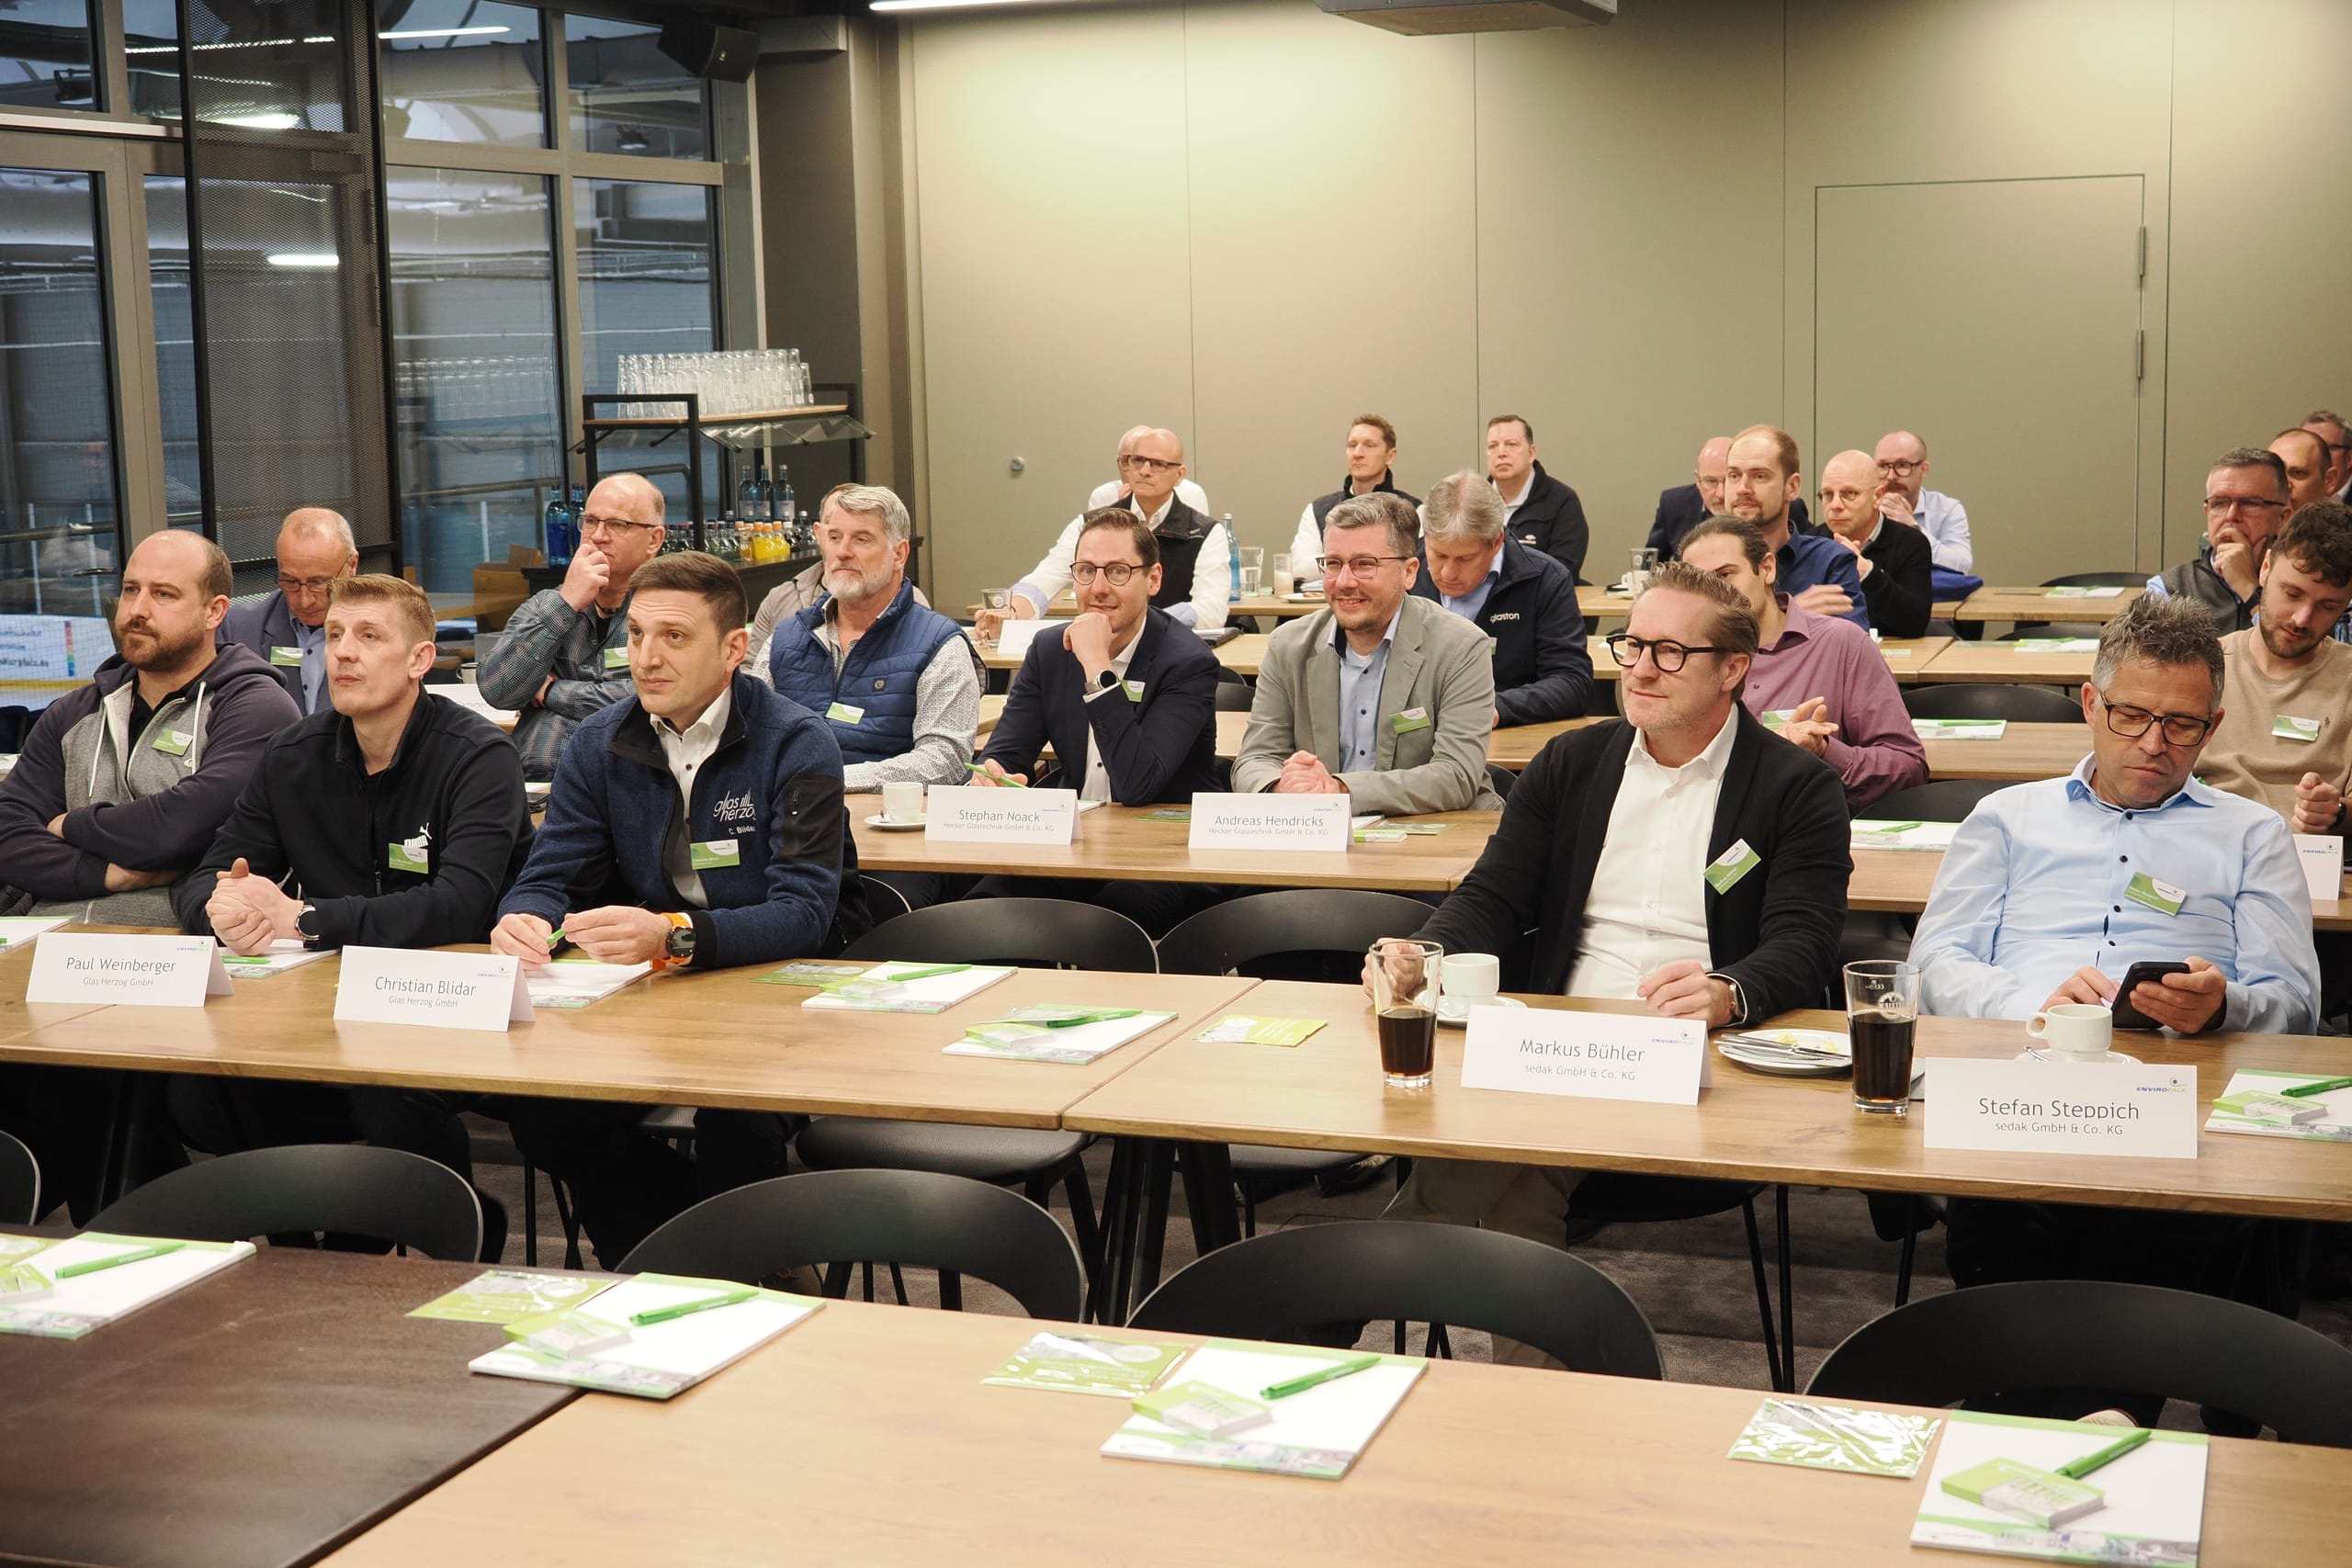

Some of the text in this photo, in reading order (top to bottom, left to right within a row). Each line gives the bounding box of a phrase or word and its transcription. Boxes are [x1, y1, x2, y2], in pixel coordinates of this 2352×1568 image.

[1489, 612, 1520, 623] glaston
[958, 809, 1040, 822] Stephan Noack
[1215, 816, 1324, 827] Andreas Hendricks
[66, 957, 176, 975] Paul Weinberger
[83, 976, 154, 987] Glas Herzog GmbH
[375, 976, 477, 996] Christian Blidar
[389, 995, 458, 1008] Glas Herzog GmbH
[1519, 1038, 1645, 1062] Markus Bühler
[1525, 1064, 1636, 1080] sedak GmbH & Co. KG
[1979, 1098, 2139, 1120] Stefan Steppich
[1996, 1121, 2123, 1135] sedak GmbH & Co. KG
